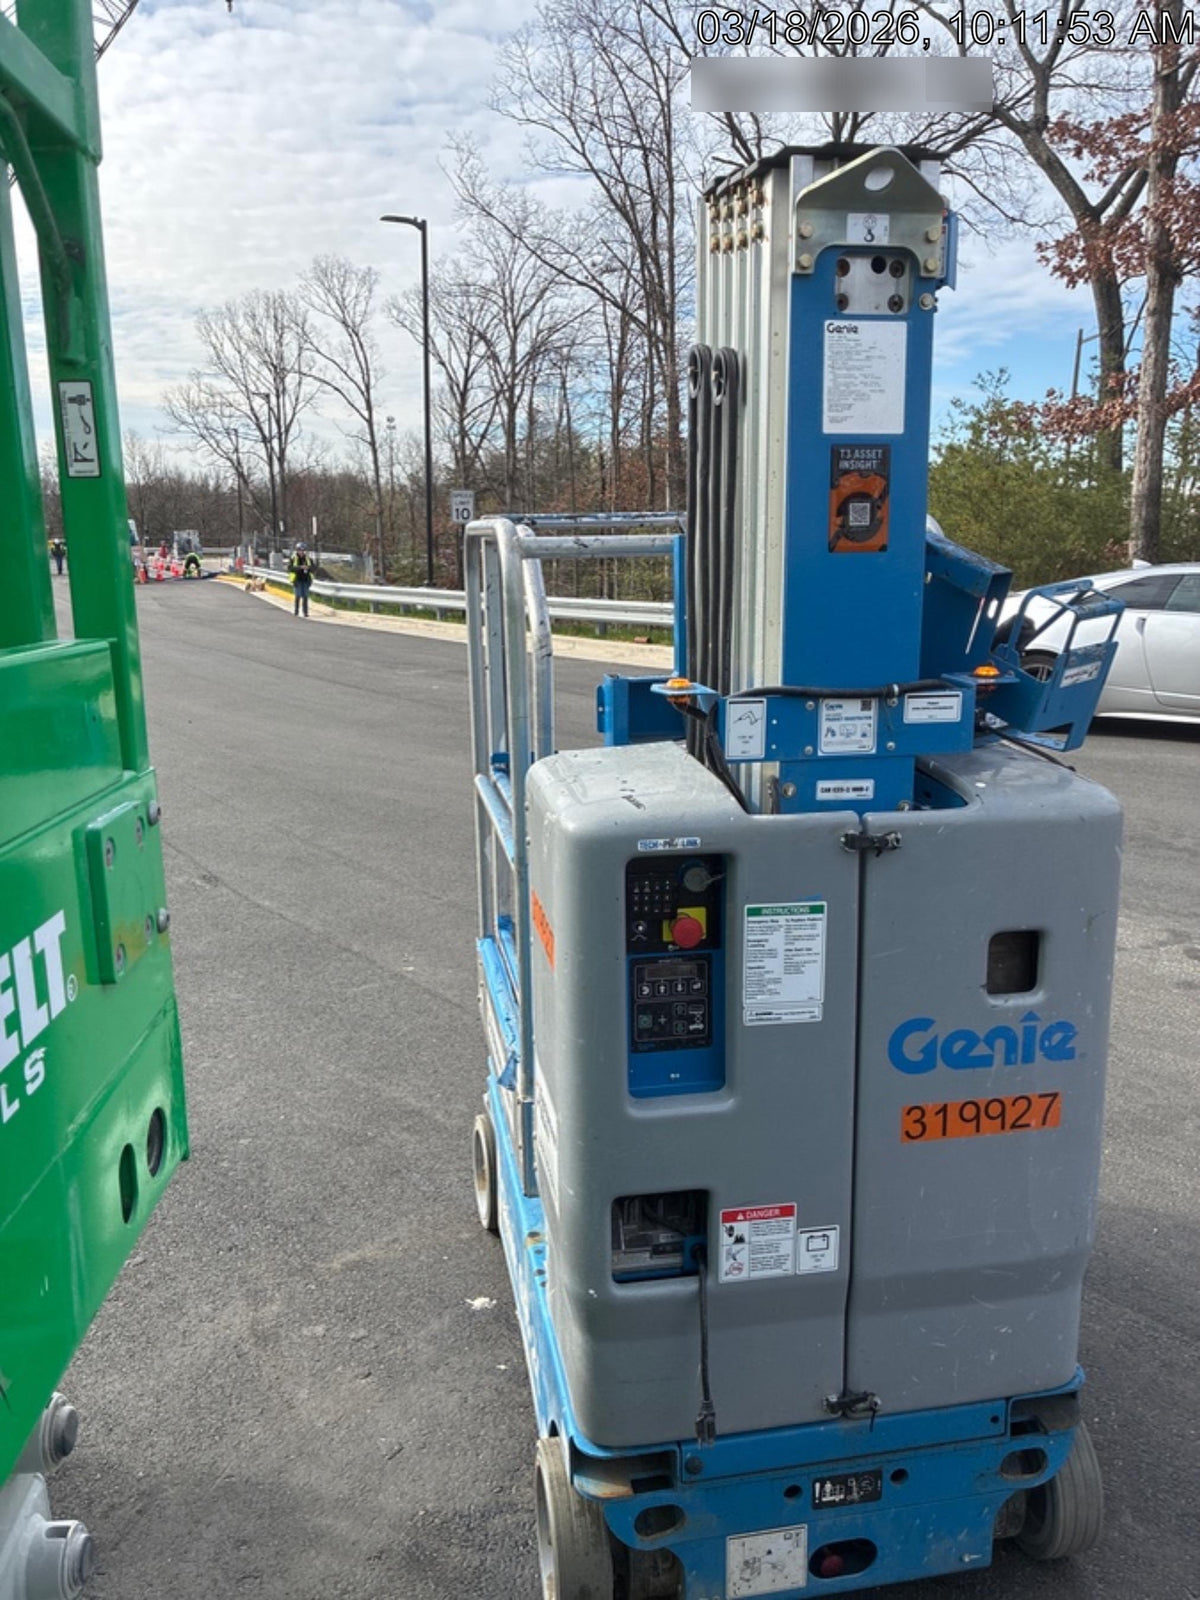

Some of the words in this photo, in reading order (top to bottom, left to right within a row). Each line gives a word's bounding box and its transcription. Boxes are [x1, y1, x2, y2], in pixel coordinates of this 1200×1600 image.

[827, 323, 858, 334] Genie
[854, 449, 883, 459] ASSET
[455, 507, 471, 520] 10
[888, 1011, 1077, 1074] Genie
[905, 1092, 1059, 1139] 319927
[746, 1208, 780, 1219] DANGER
